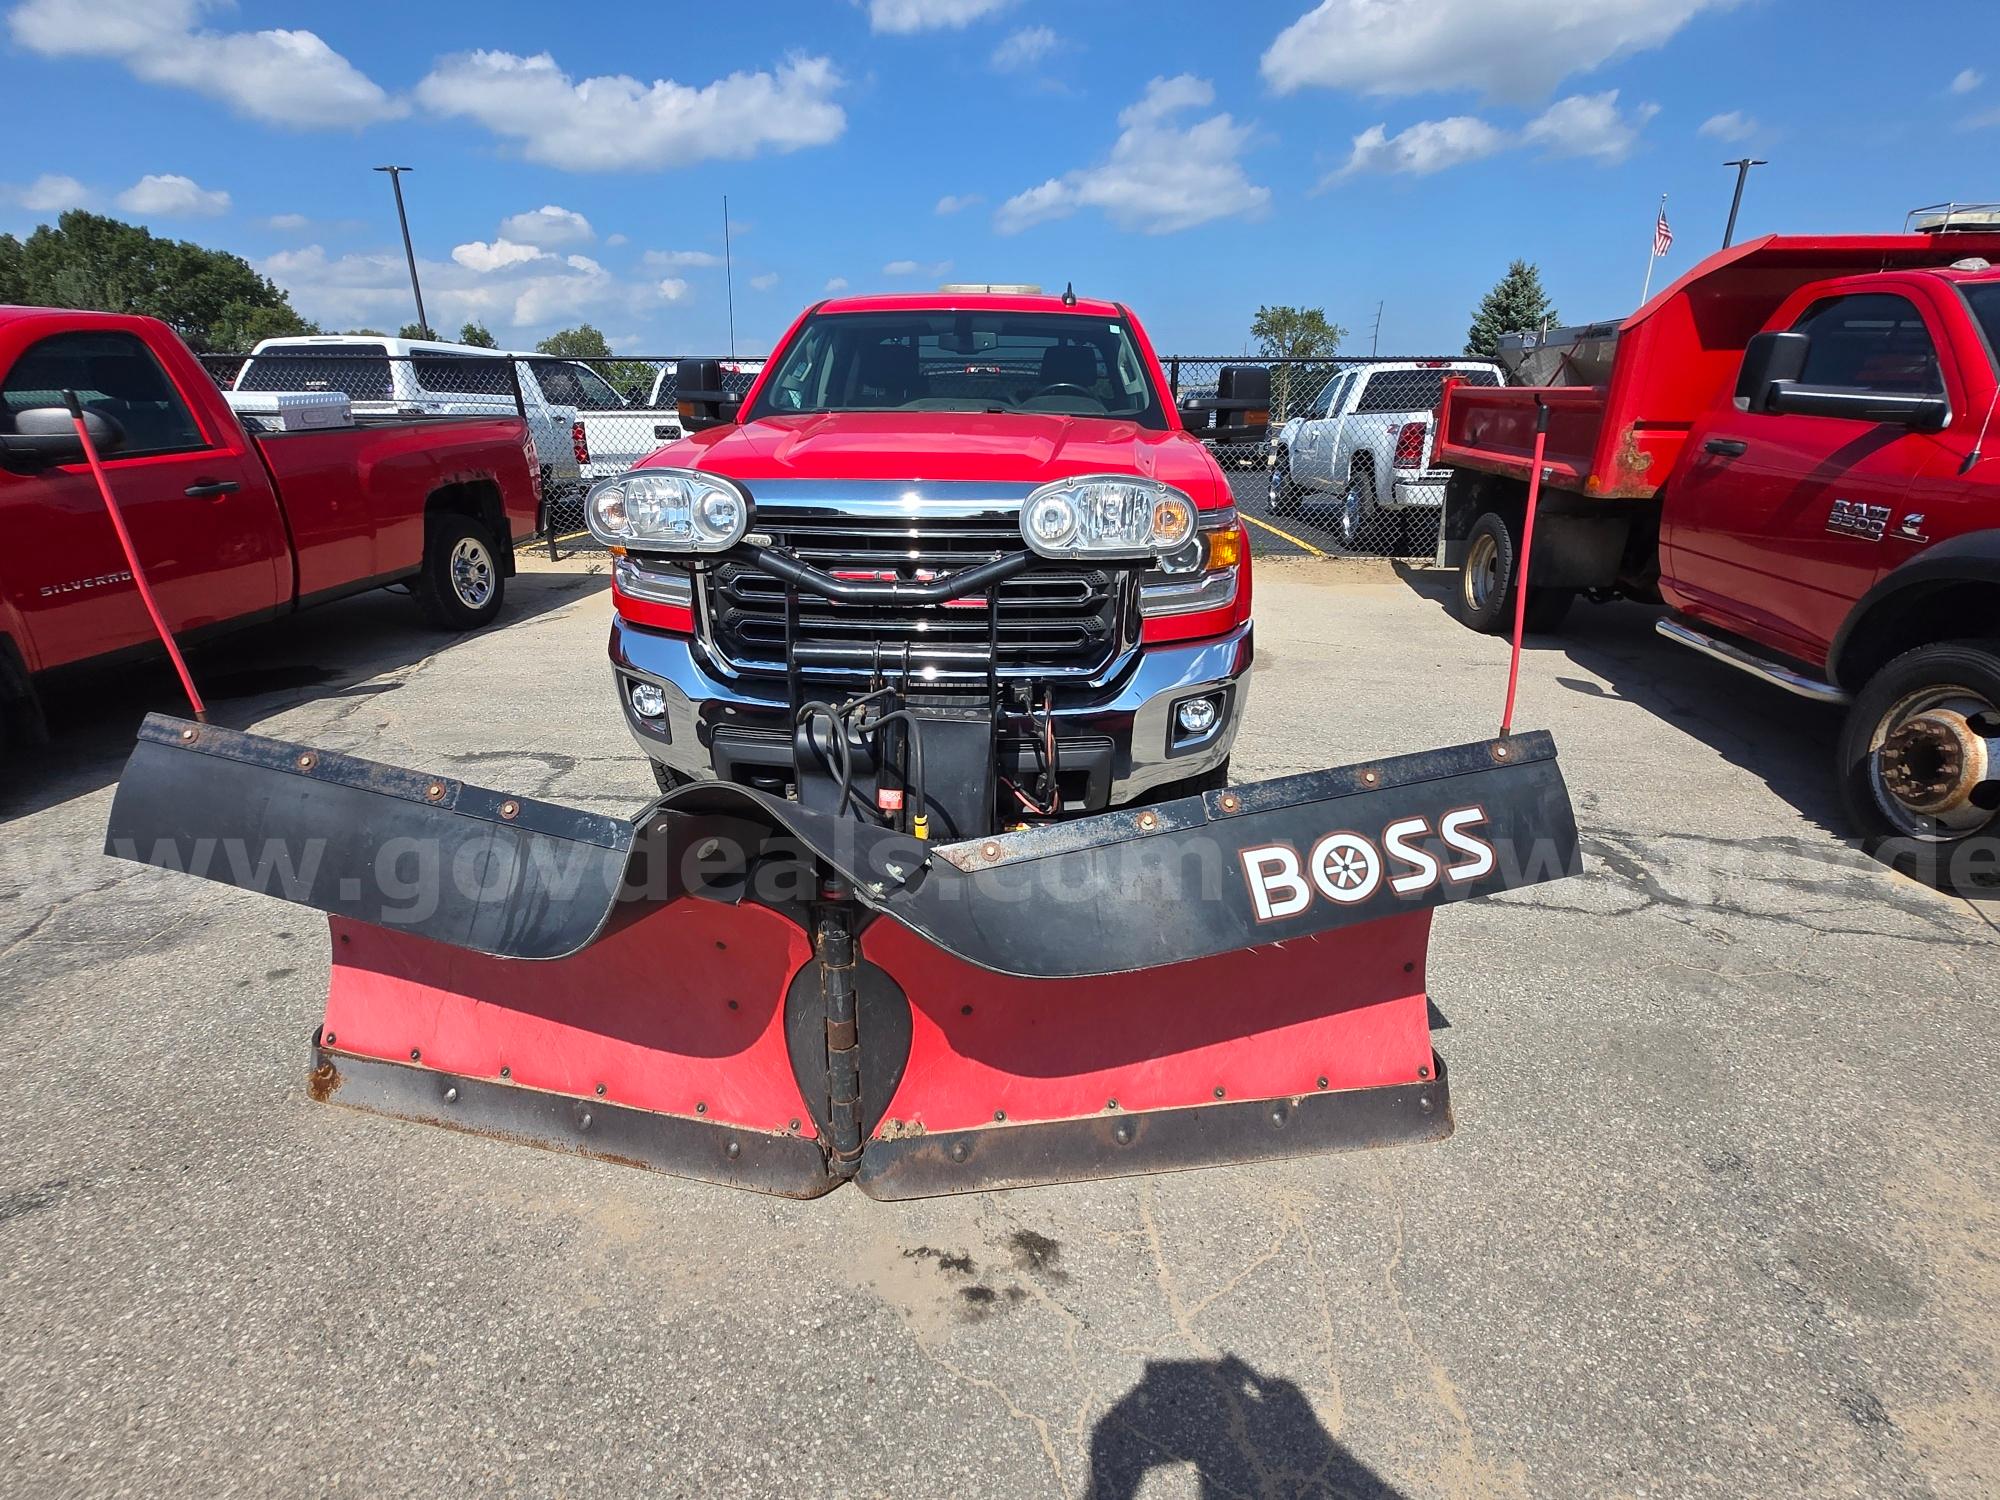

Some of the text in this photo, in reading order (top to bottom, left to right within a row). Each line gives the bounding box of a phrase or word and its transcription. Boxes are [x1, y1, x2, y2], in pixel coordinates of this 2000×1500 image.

[1833, 499, 1892, 521] RAM
[40, 571, 132, 597] SILVERAD
[1238, 805, 1496, 923] BOSS
